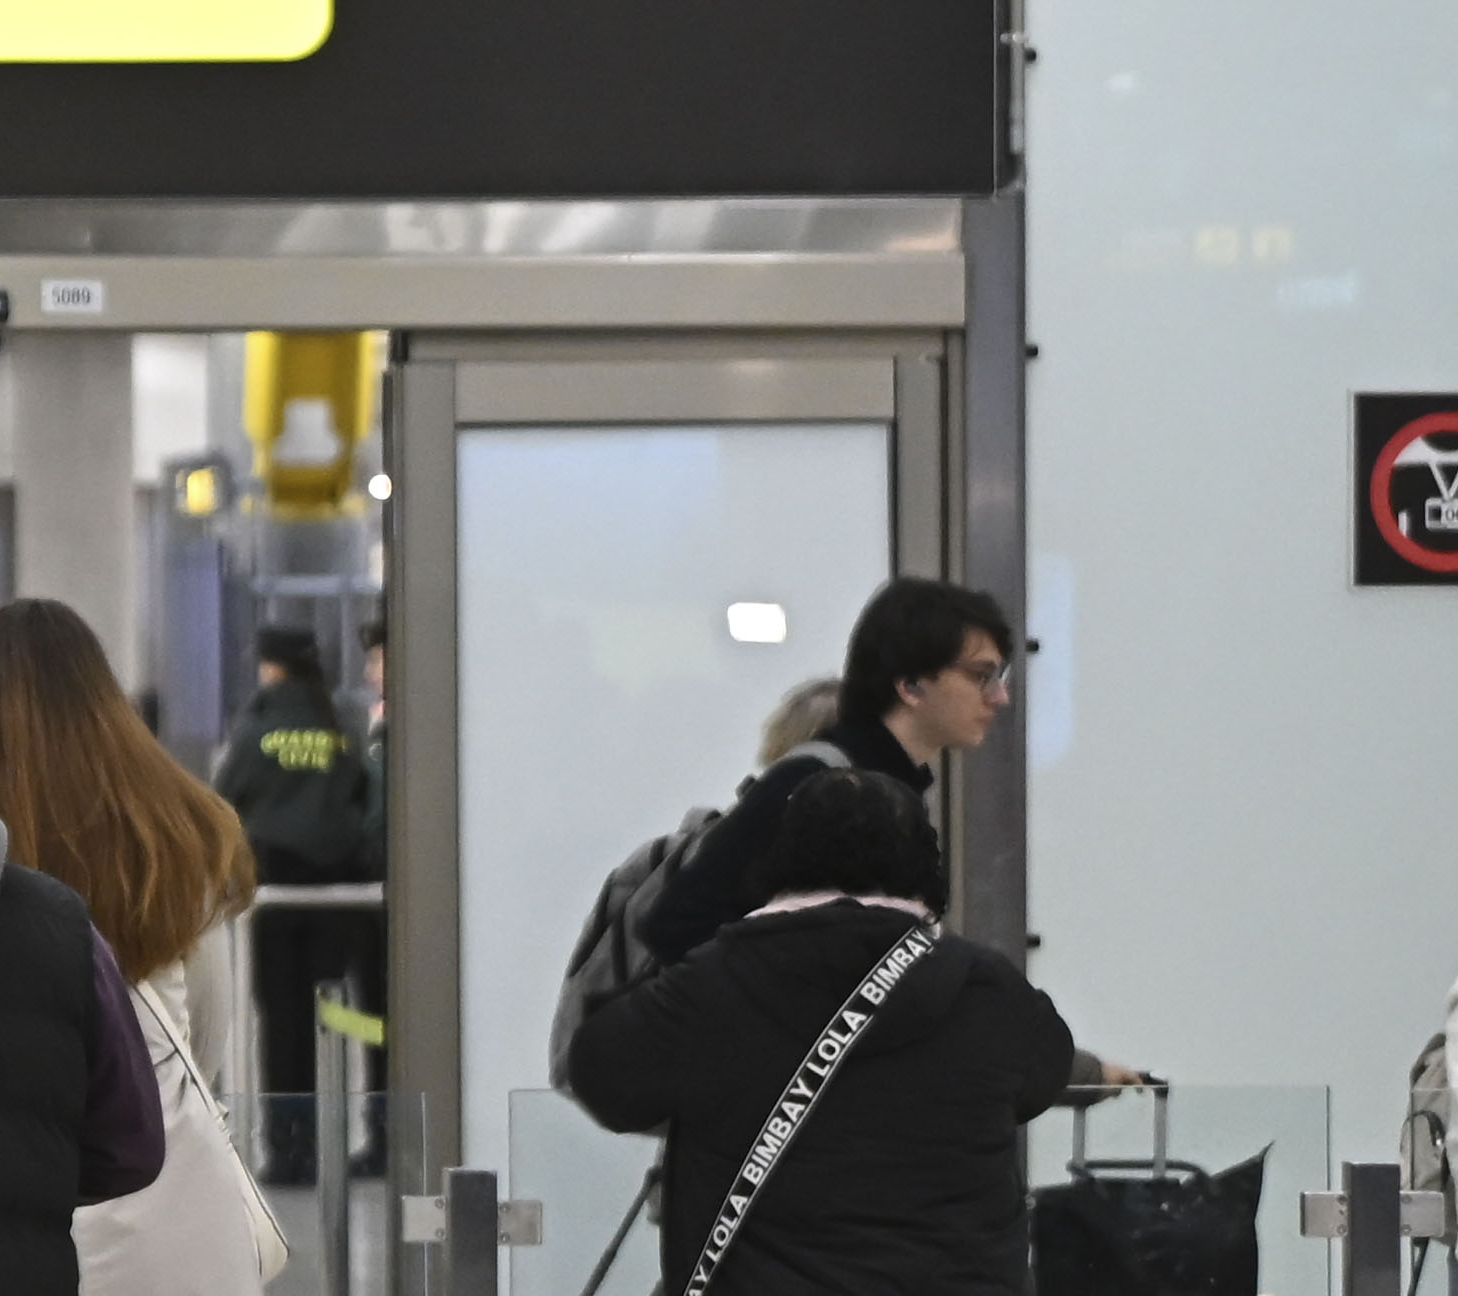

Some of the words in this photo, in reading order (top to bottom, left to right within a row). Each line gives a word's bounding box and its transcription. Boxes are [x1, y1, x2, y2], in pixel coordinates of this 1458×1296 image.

[705, 1194, 749, 1263] LOLA
[741, 1076, 814, 1185] BIMBAY
[806, 1010, 868, 1077] LOLA
[859, 929, 932, 1005] BIMBAY
